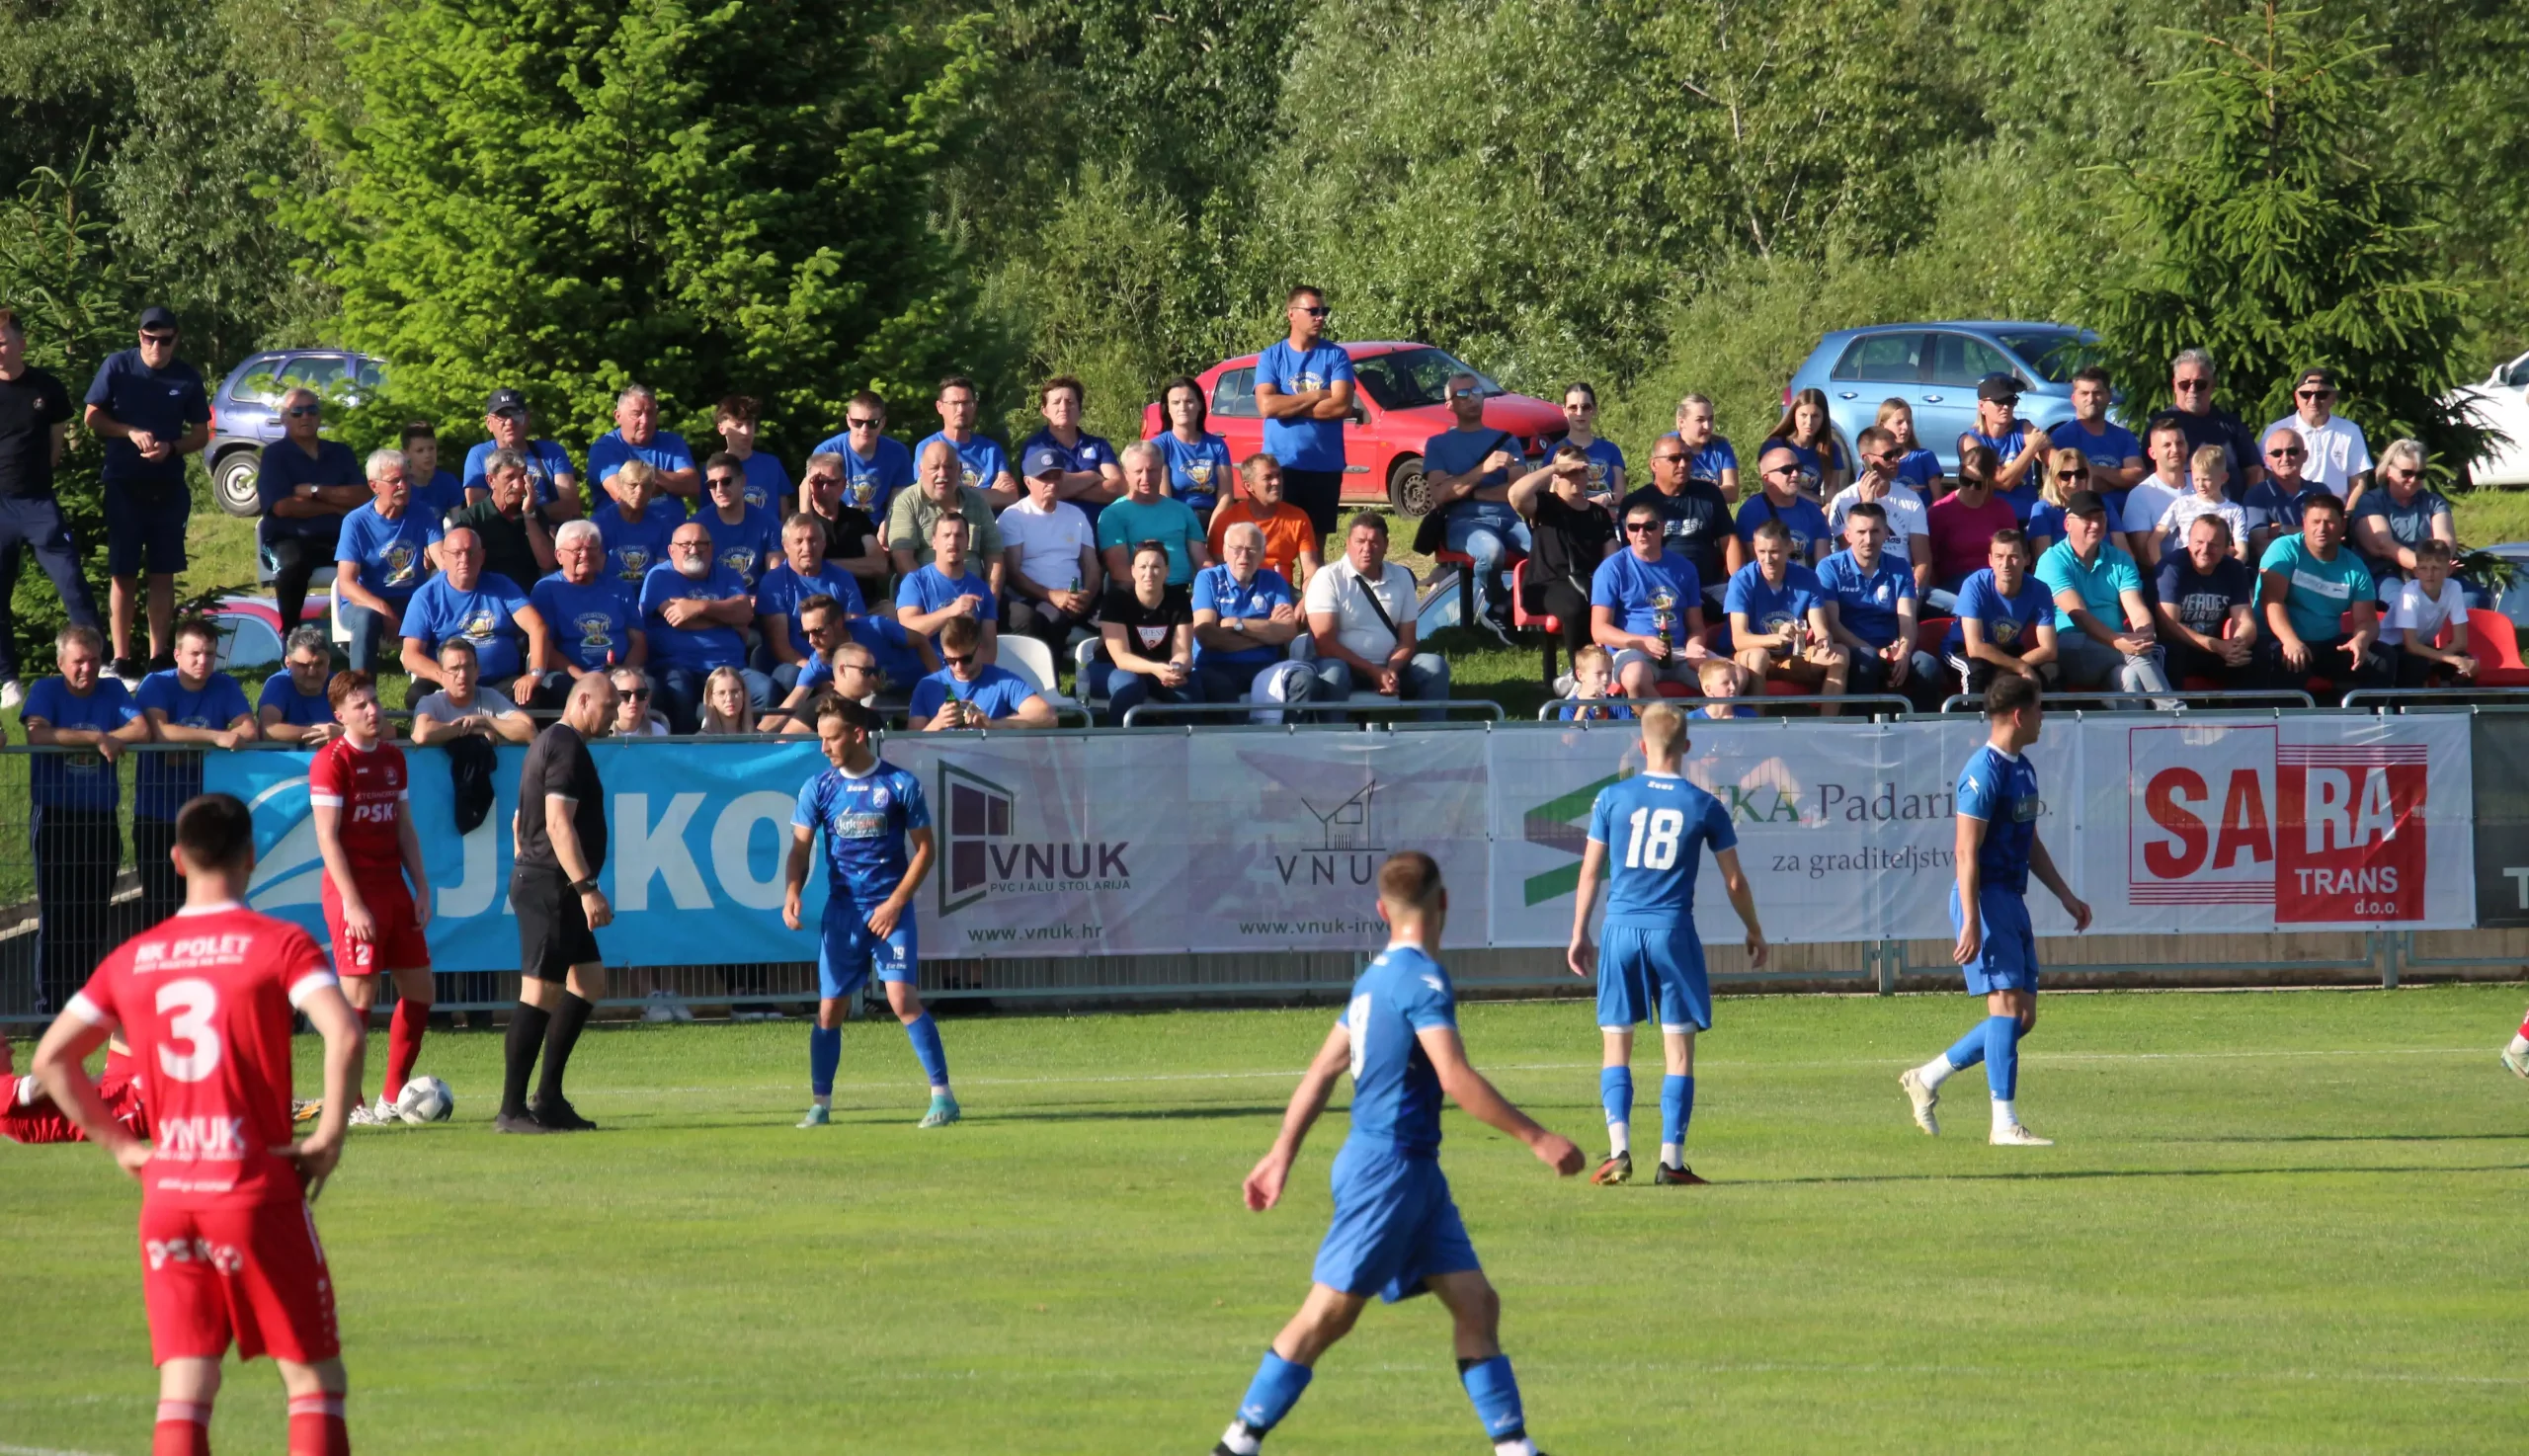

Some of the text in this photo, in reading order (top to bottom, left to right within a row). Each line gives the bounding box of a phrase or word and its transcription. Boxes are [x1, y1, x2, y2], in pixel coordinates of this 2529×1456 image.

[1140, 628, 1165, 637] GUESS
[353, 803, 393, 822] PSK
[1711, 780, 1957, 823] KA Padari
[1625, 806, 1683, 870] 18
[2144, 767, 2397, 879] SARA
[437, 790, 817, 918] JKO
[989, 842, 1130, 880] VNUK
[1274, 854, 1392, 886] VNU
[1772, 846, 1958, 879] za graditeljstv
[990, 880, 1131, 893] PVC I ALU STOLARIJA
[2294, 866, 2399, 895] TRANS
[2354, 899, 2399, 915] d.o.o.
[967, 924, 1103, 941] www.vnuk.hr
[134, 941, 167, 965] NK
[172, 933, 253, 961] POLET
[356, 944, 369, 965] 2
[893, 945, 905, 960] 19
[155, 977, 221, 1083] 3
